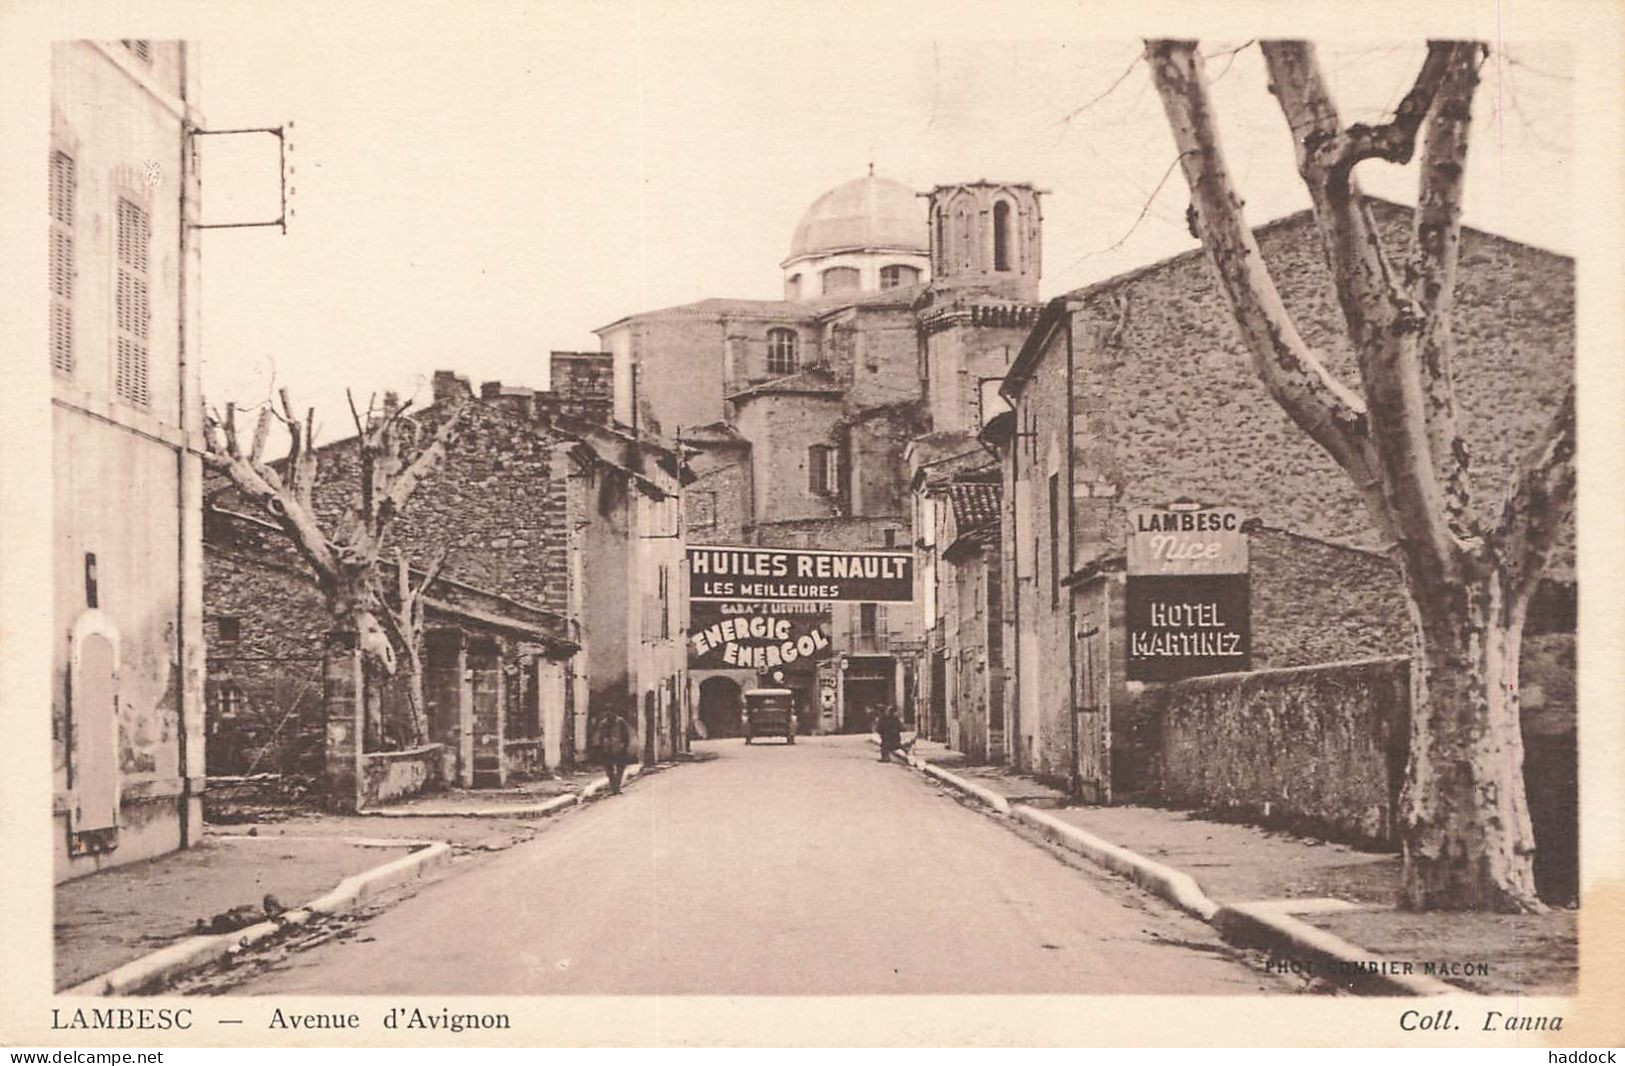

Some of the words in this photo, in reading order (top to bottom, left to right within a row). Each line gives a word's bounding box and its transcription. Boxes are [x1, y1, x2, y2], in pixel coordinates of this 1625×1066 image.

[1138, 514, 1237, 532] LAMBESC
[1151, 535, 1222, 559] Nice
[692, 552, 788, 577] HUILES
[796, 555, 907, 579] RENAULT
[703, 582, 734, 595] LES
[740, 584, 840, 597] MEILLEURES
[1151, 603, 1226, 627] HOTEL
[691, 616, 792, 656] ENERGIC
[1131, 630, 1244, 656] MARTINEZ
[722, 630, 829, 668] ENERGOL
